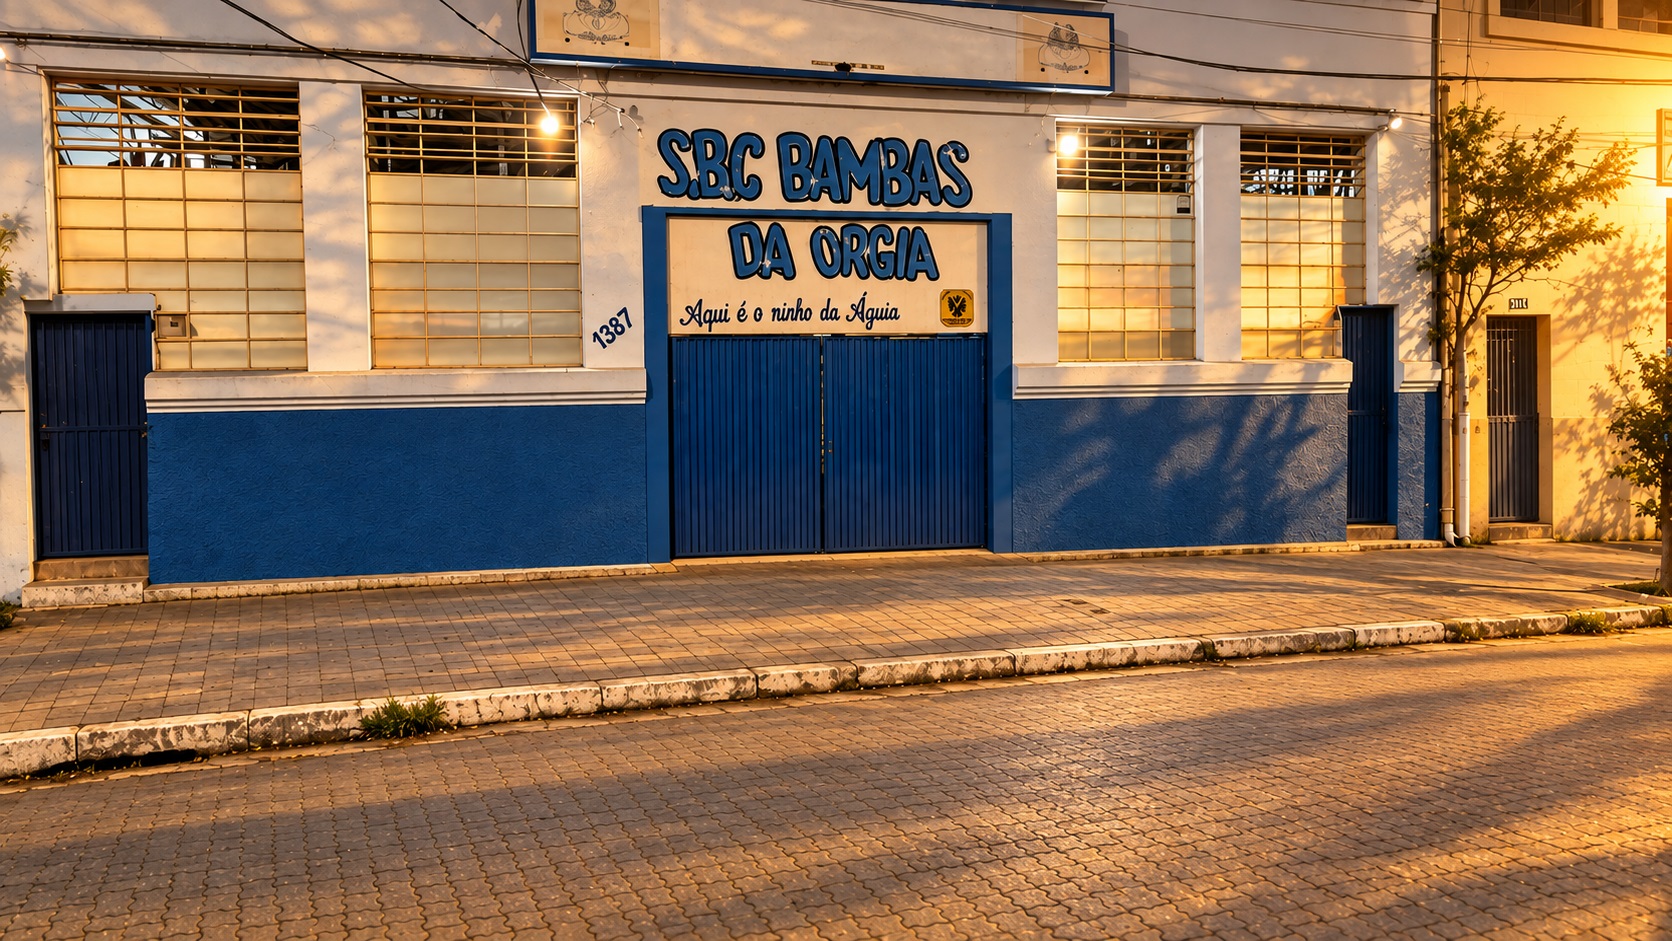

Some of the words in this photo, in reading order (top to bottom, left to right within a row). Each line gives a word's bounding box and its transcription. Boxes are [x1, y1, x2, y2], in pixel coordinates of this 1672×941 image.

[776, 131, 973, 207] BAMBAS
[727, 221, 796, 280] DA
[809, 223, 939, 281] ORGIA
[592, 306, 633, 349] 1387
[679, 298, 731, 332] Aqui
[736, 300, 748, 322] é
[753, 307, 763, 322] o
[771, 297, 813, 322] ninho
[819, 298, 841, 322] da
[845, 291, 901, 331] Águia
